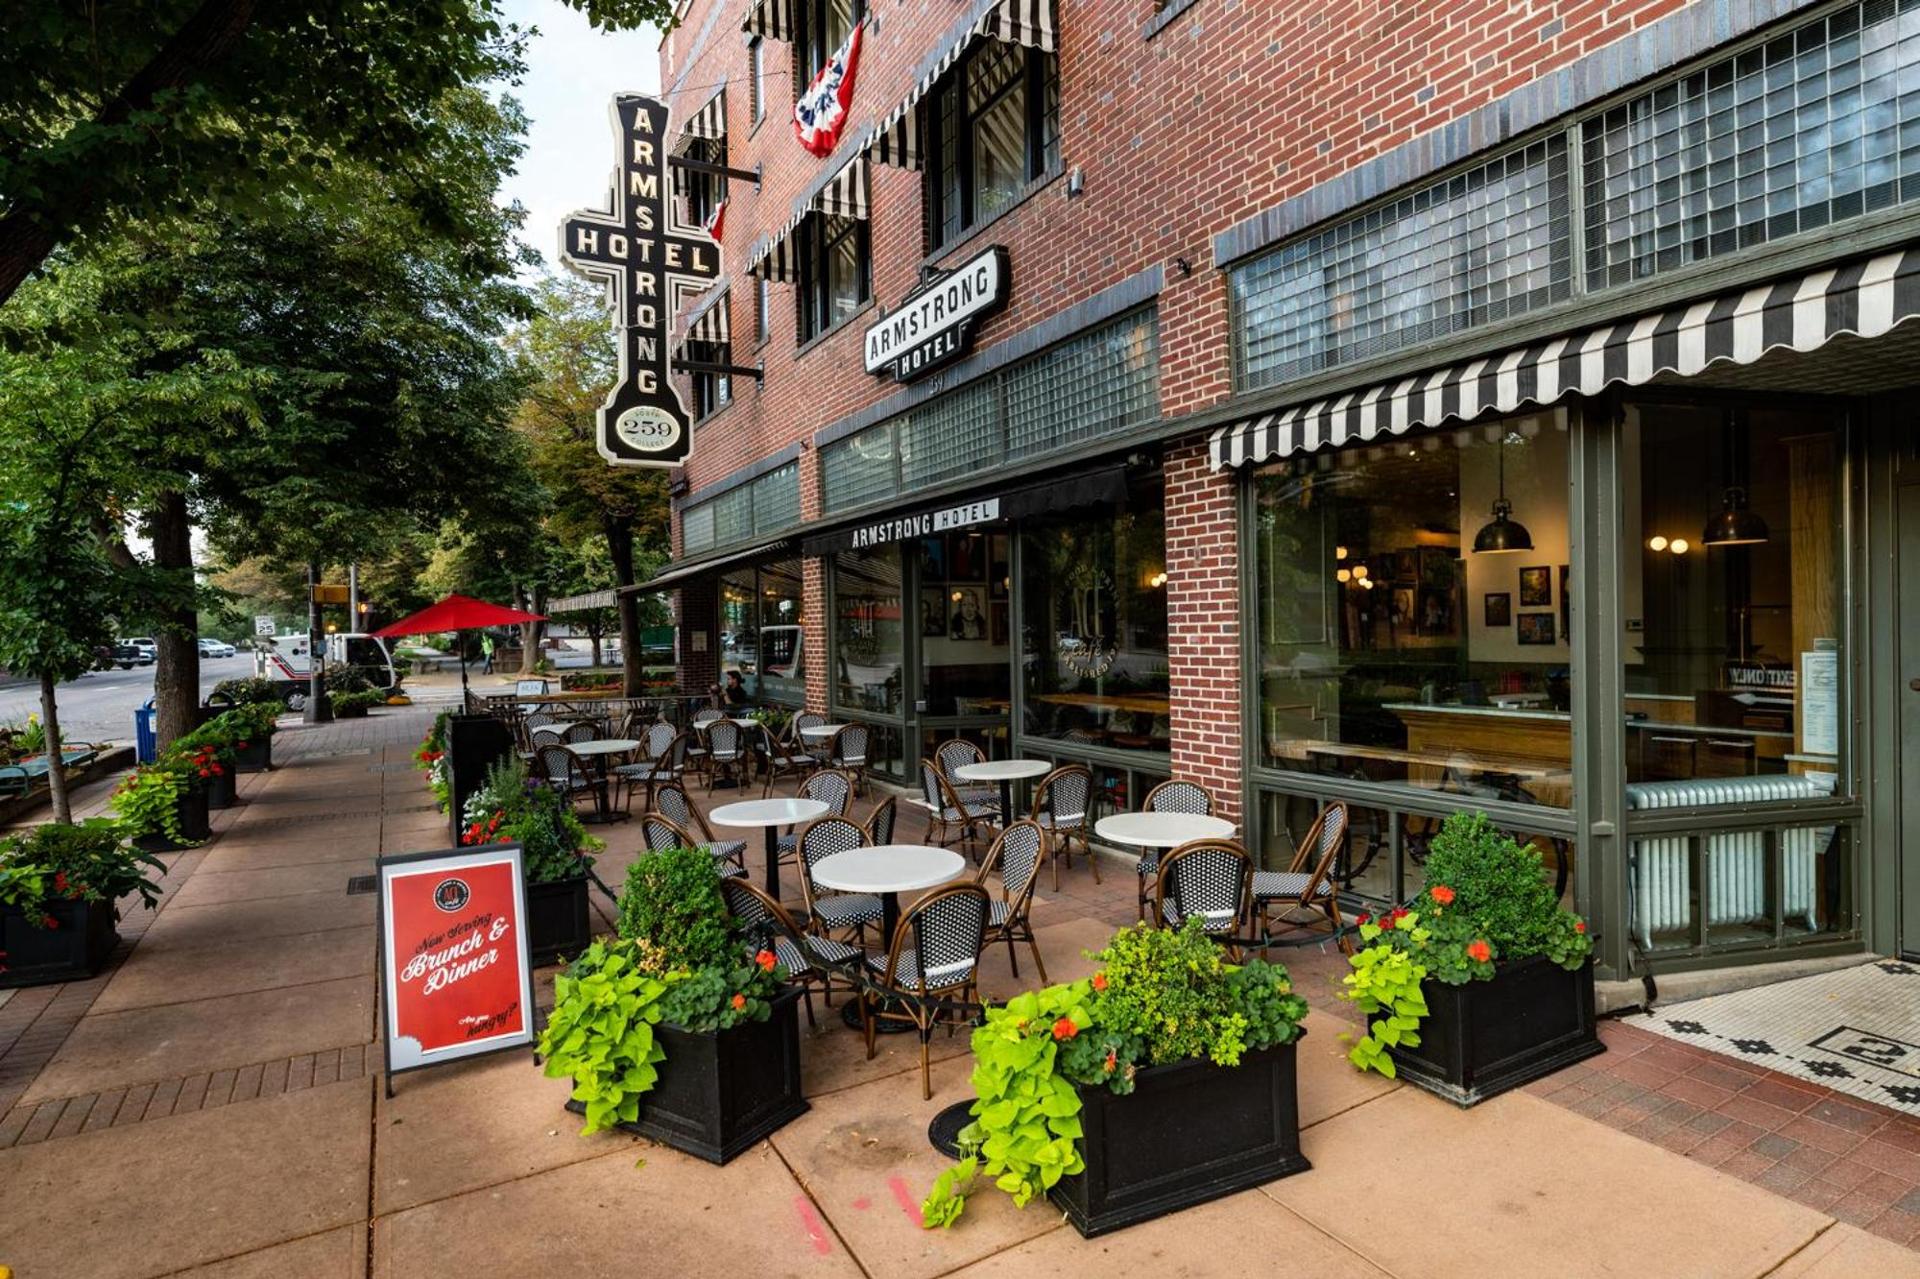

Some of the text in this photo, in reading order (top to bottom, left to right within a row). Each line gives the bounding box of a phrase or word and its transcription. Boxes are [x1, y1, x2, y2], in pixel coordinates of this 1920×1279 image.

[576, 227, 711, 272] HOTEL
[630, 106, 658, 395] ARMSTRONG
[870, 265, 988, 361] ARMSTRONG
[901, 332, 955, 375] HOTEL
[624, 419, 672, 437] 259
[852, 503, 990, 548] ARMSTRONG HOTEL
[259, 625, 273, 634] 25
[447, 913, 493, 939] Serving
[400, 916, 510, 983] Brunch &
[423, 948, 499, 996] Dinner
[465, 1002, 518, 1039] hungry?
